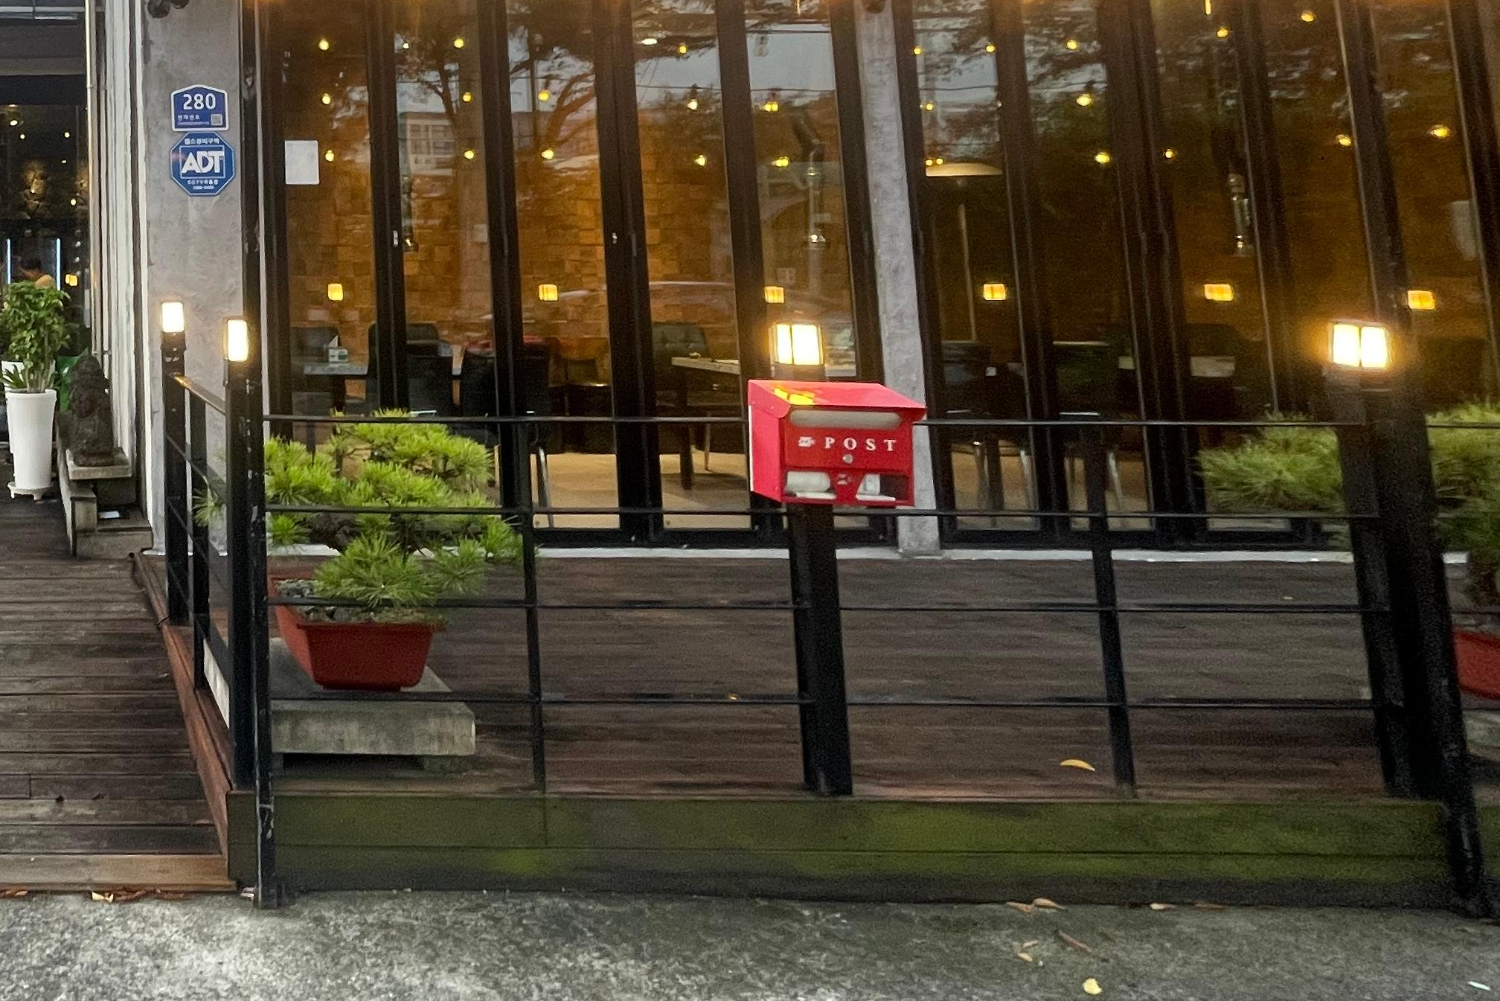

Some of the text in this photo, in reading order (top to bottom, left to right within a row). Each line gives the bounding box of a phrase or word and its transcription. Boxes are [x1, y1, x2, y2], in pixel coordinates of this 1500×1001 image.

[183, 93, 216, 110] 280
[181, 150, 225, 174] ADT
[825, 437, 896, 451] POST
